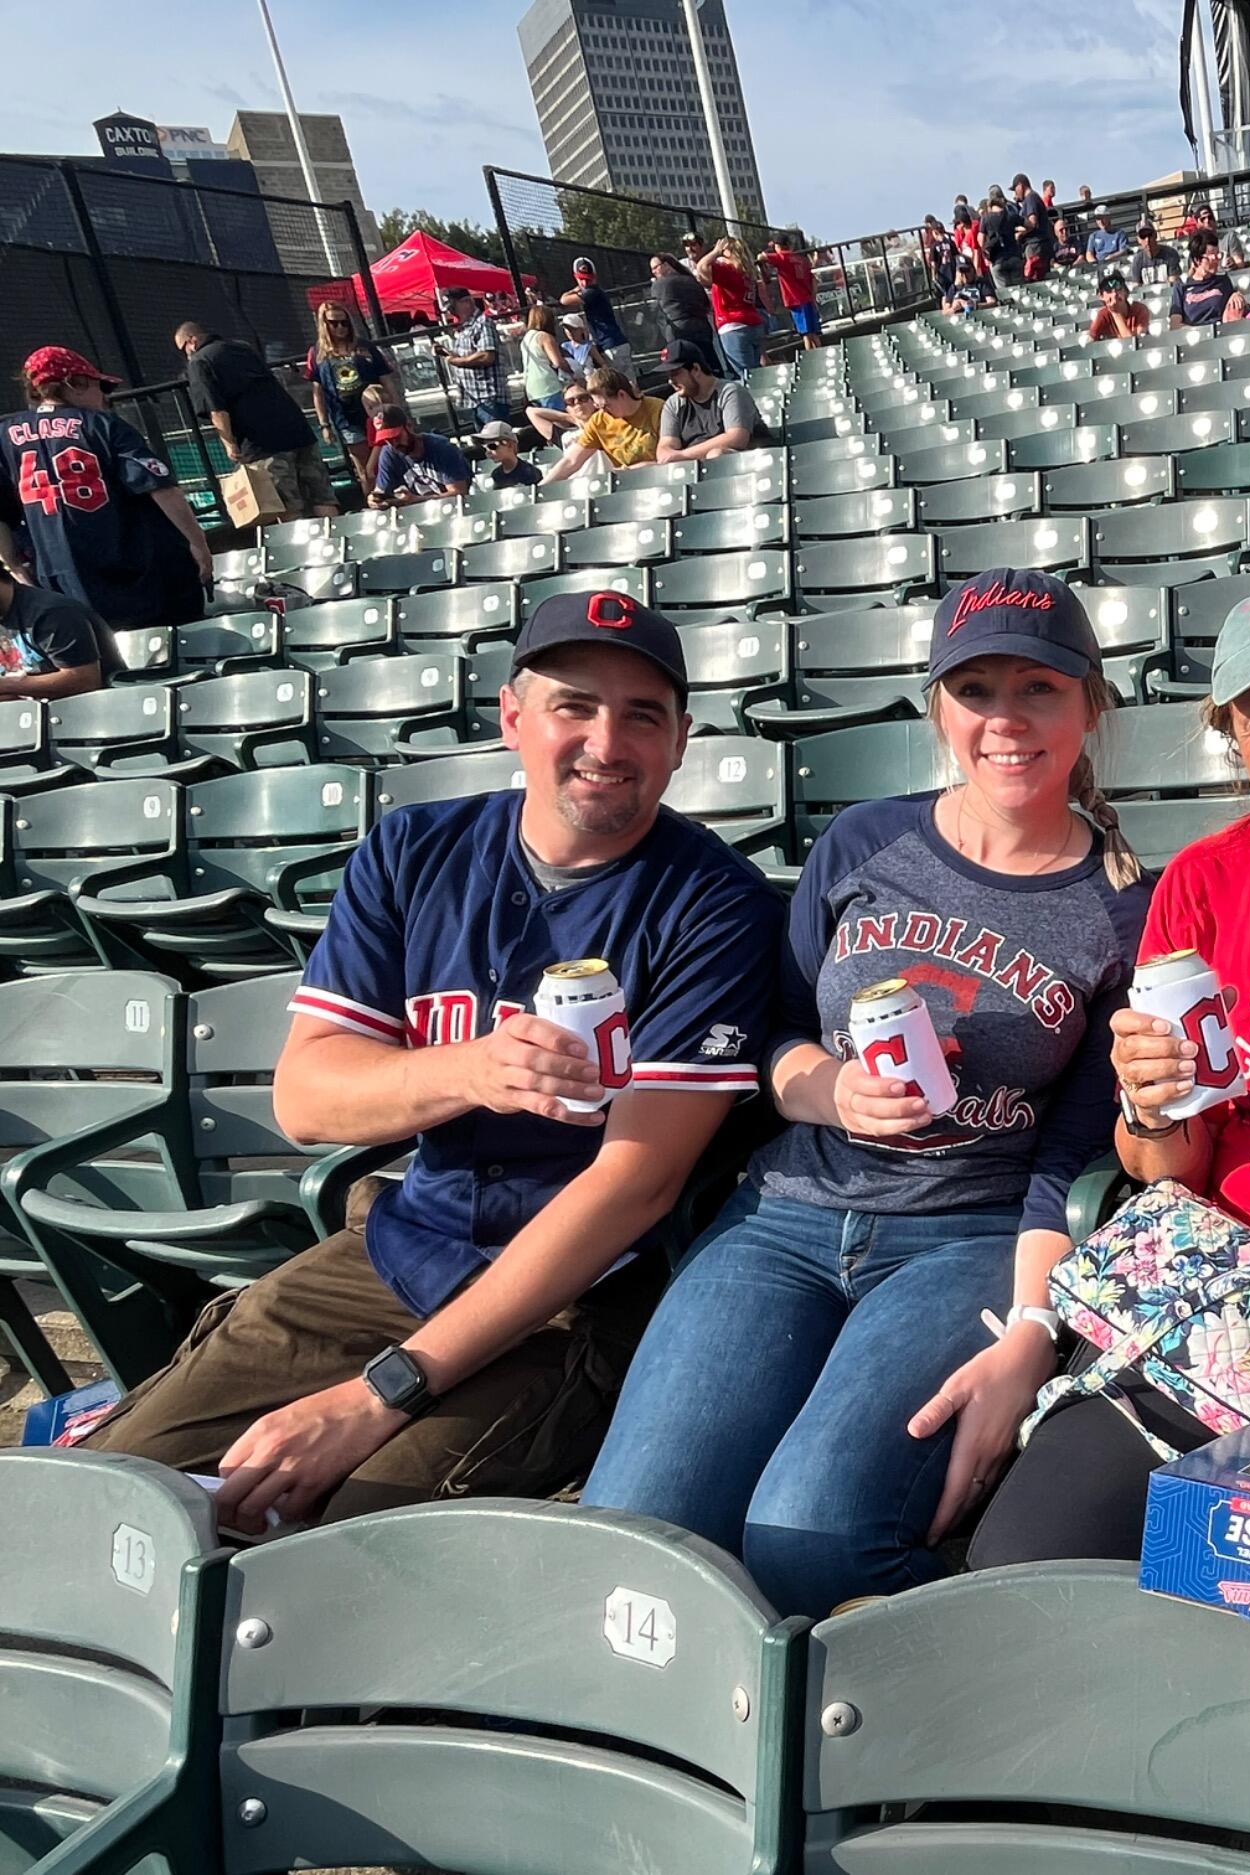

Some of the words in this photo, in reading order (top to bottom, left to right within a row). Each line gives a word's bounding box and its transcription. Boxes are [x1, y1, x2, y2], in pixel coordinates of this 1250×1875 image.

[105, 127, 157, 144] CAXTO
[169, 128, 207, 143] PNC
[8, 418, 82, 446] CLASE
[18, 446, 109, 516] 48
[587, 588, 635, 631] C
[947, 582, 1056, 637] Indians
[727, 760, 742, 778] 12
[834, 911, 1076, 1028] INDIANS
[131, 1005, 145, 1028] 11
[593, 1010, 632, 1090] C
[1181, 990, 1249, 1090] C
[122, 1539, 147, 1576] 13
[620, 1601, 660, 1652] 14
